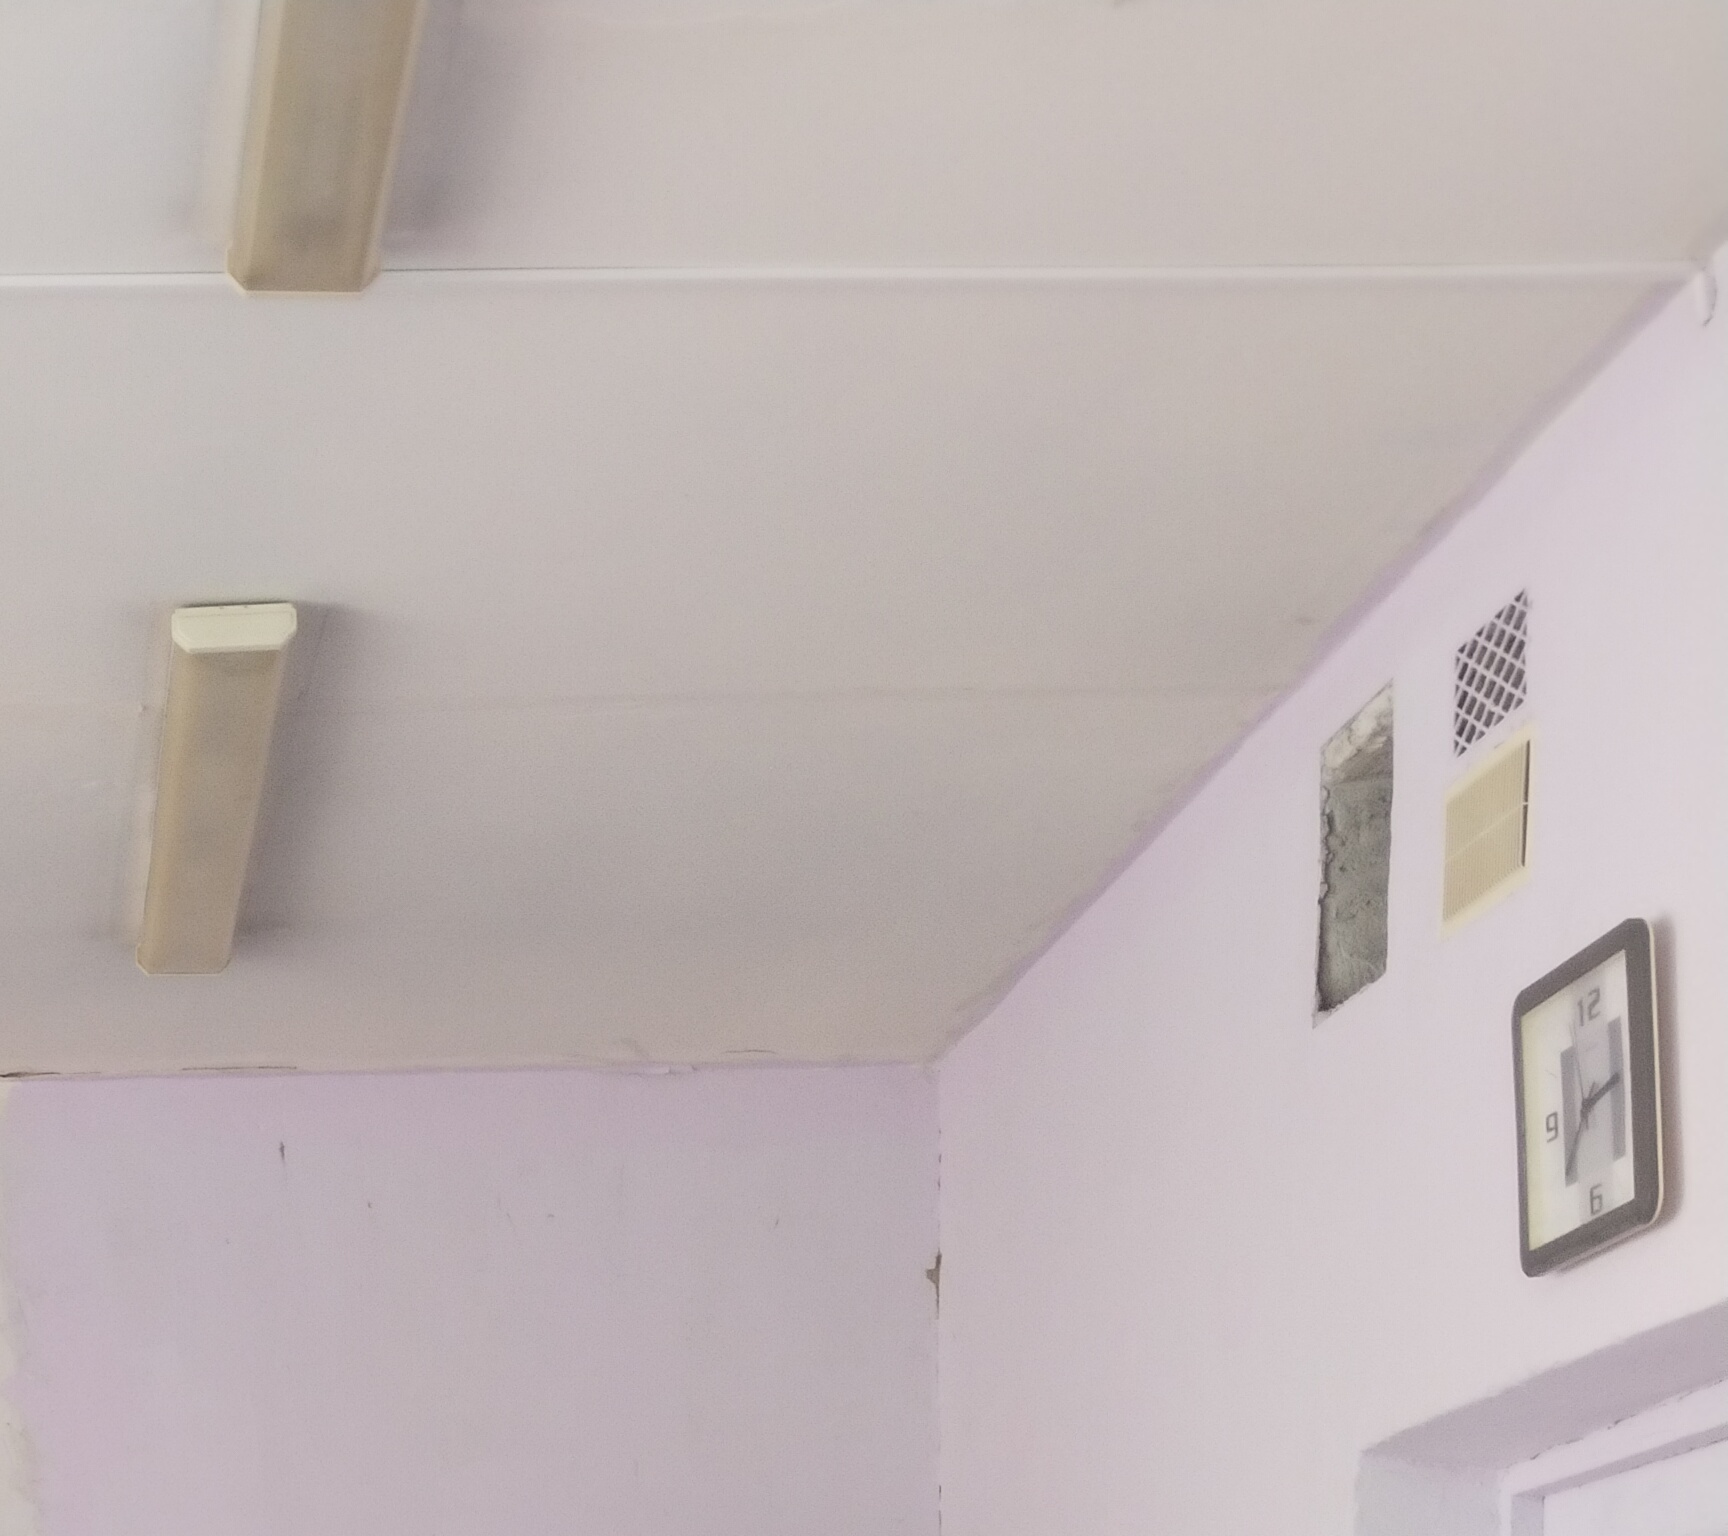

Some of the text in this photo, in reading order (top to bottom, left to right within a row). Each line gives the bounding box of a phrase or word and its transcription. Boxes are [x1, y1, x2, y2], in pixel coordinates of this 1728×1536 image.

[1577, 988, 1601, 1026] 12
[1546, 1111, 1558, 1143] 9
[1589, 1184, 1603, 1216] 6
